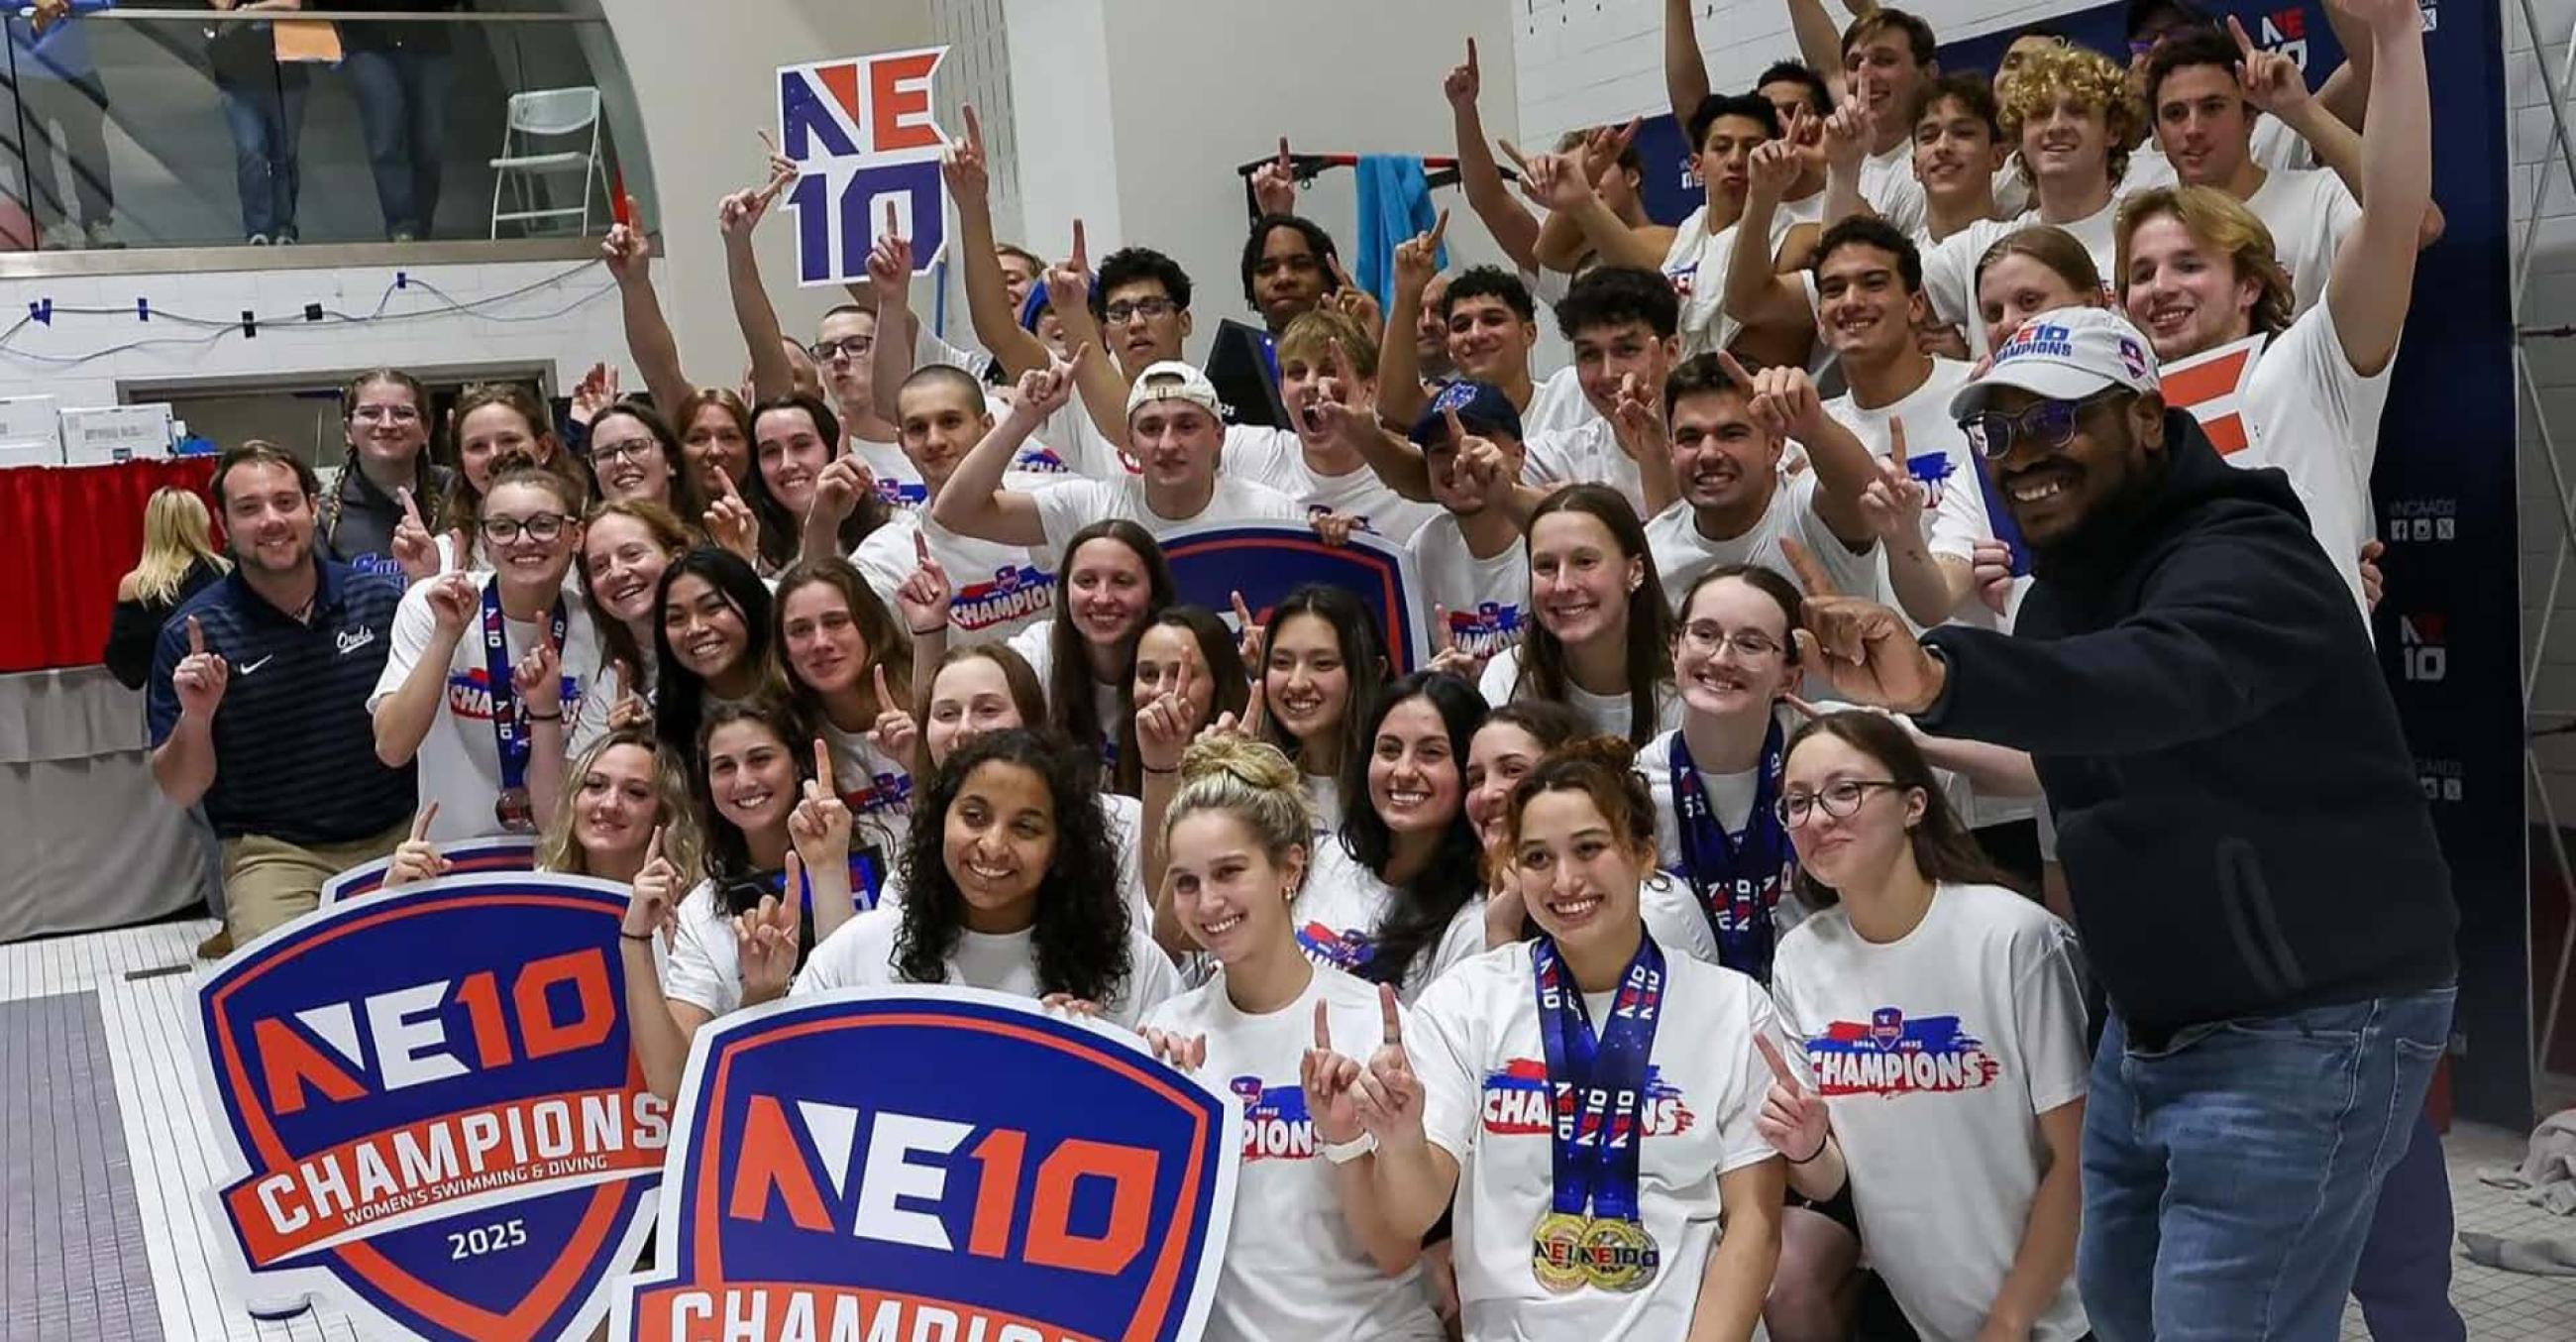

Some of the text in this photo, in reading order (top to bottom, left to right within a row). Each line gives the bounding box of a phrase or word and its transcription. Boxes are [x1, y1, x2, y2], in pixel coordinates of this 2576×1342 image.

[2262, 10, 2305, 45] NE
[782, 54, 942, 161] NE
[788, 161, 943, 281] 10
[2404, 646, 2446, 681] 10
[254, 948, 615, 1115] NE10
[257, 1091, 669, 1235] CHAMPIONS
[343, 1155, 607, 1226] WOMEN'S SWIMMING & DIVING
[729, 1094, 1160, 1276] NE10
[448, 1218, 528, 1261] 2025
